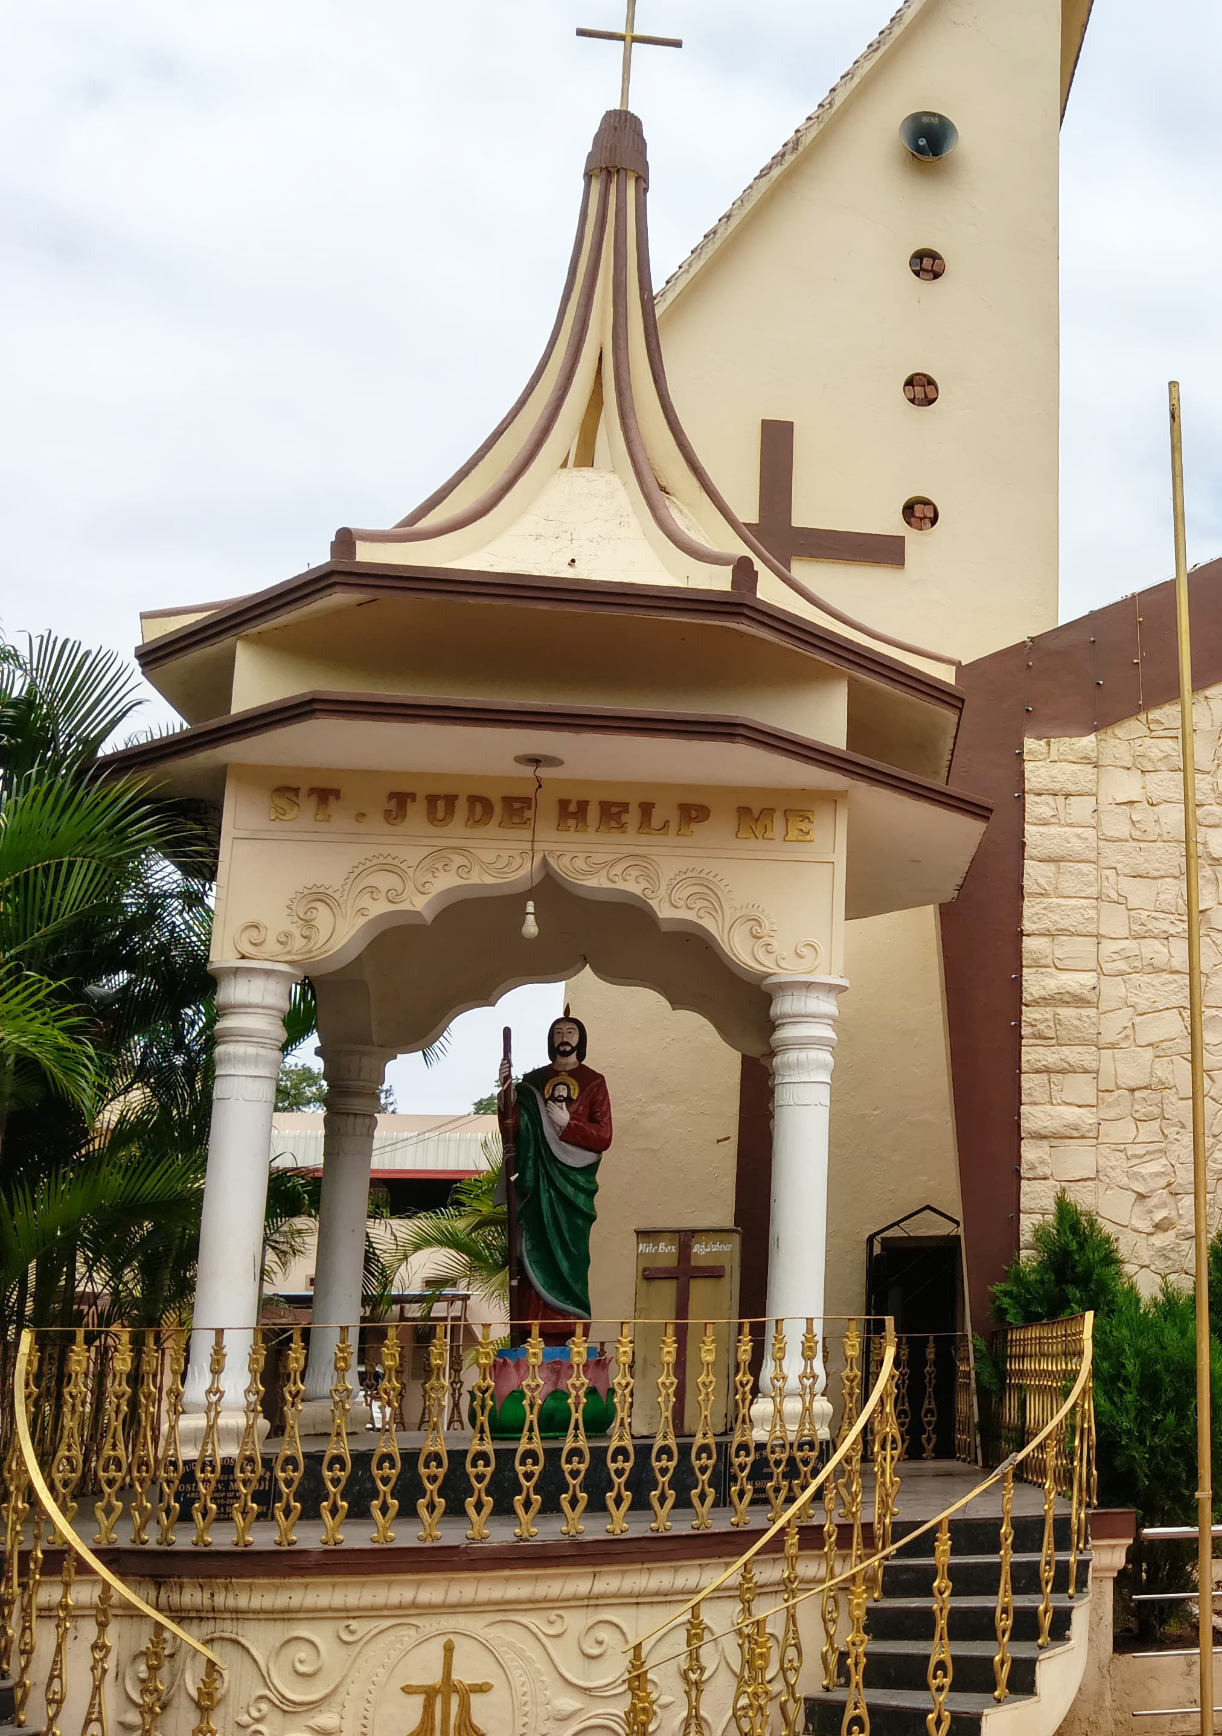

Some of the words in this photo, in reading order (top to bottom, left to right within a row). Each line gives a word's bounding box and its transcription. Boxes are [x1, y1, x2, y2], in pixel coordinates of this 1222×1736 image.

[269, 786, 367, 823] ST.
[384, 791, 533, 830] JUDE
[556, 798, 710, 836] HELP
[736, 806, 816, 843] ME
[658, 1242, 676, 1253] Box
